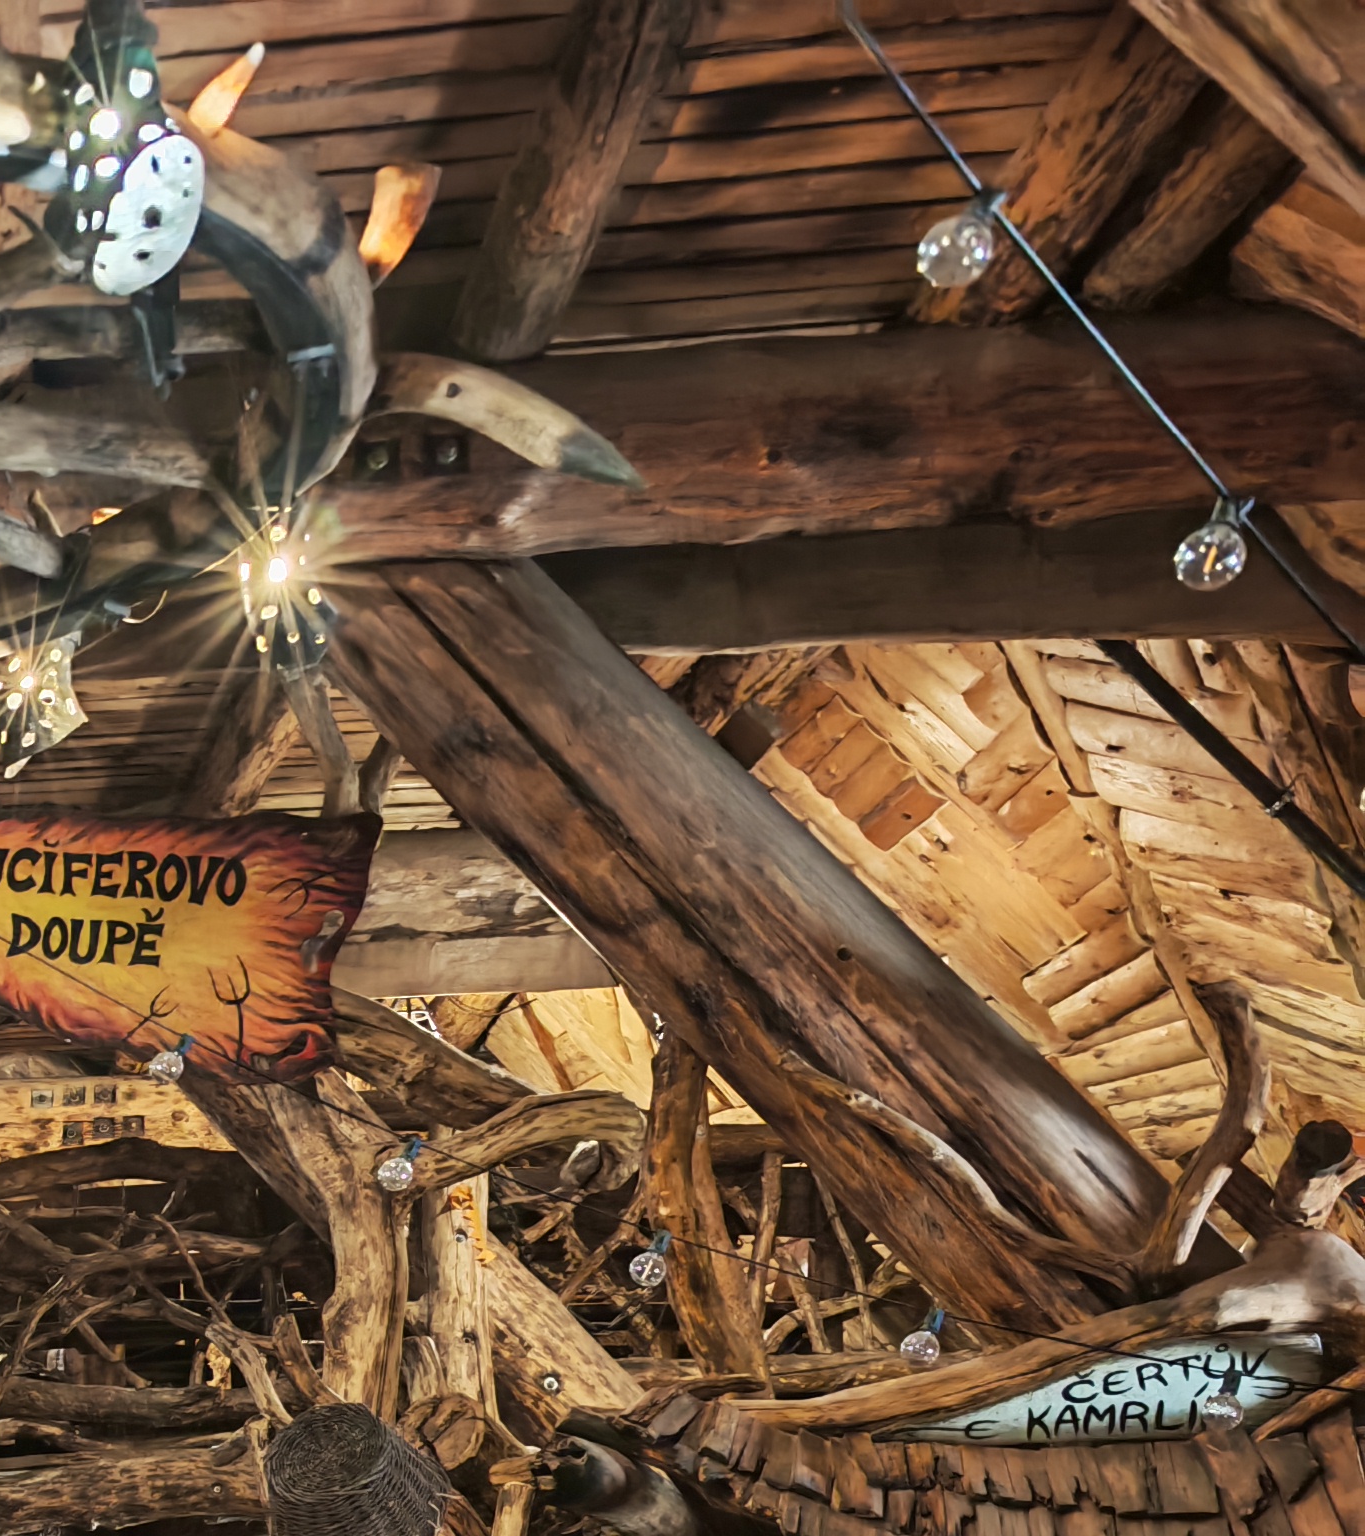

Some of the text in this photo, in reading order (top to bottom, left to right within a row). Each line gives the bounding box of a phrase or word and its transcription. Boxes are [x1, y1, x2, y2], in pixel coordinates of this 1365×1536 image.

[6, 908, 165, 967] DOUPĚ
[1060, 1343, 1271, 1404] ČERTŮV
[1026, 1382, 1205, 1441] KAMRLÍ
